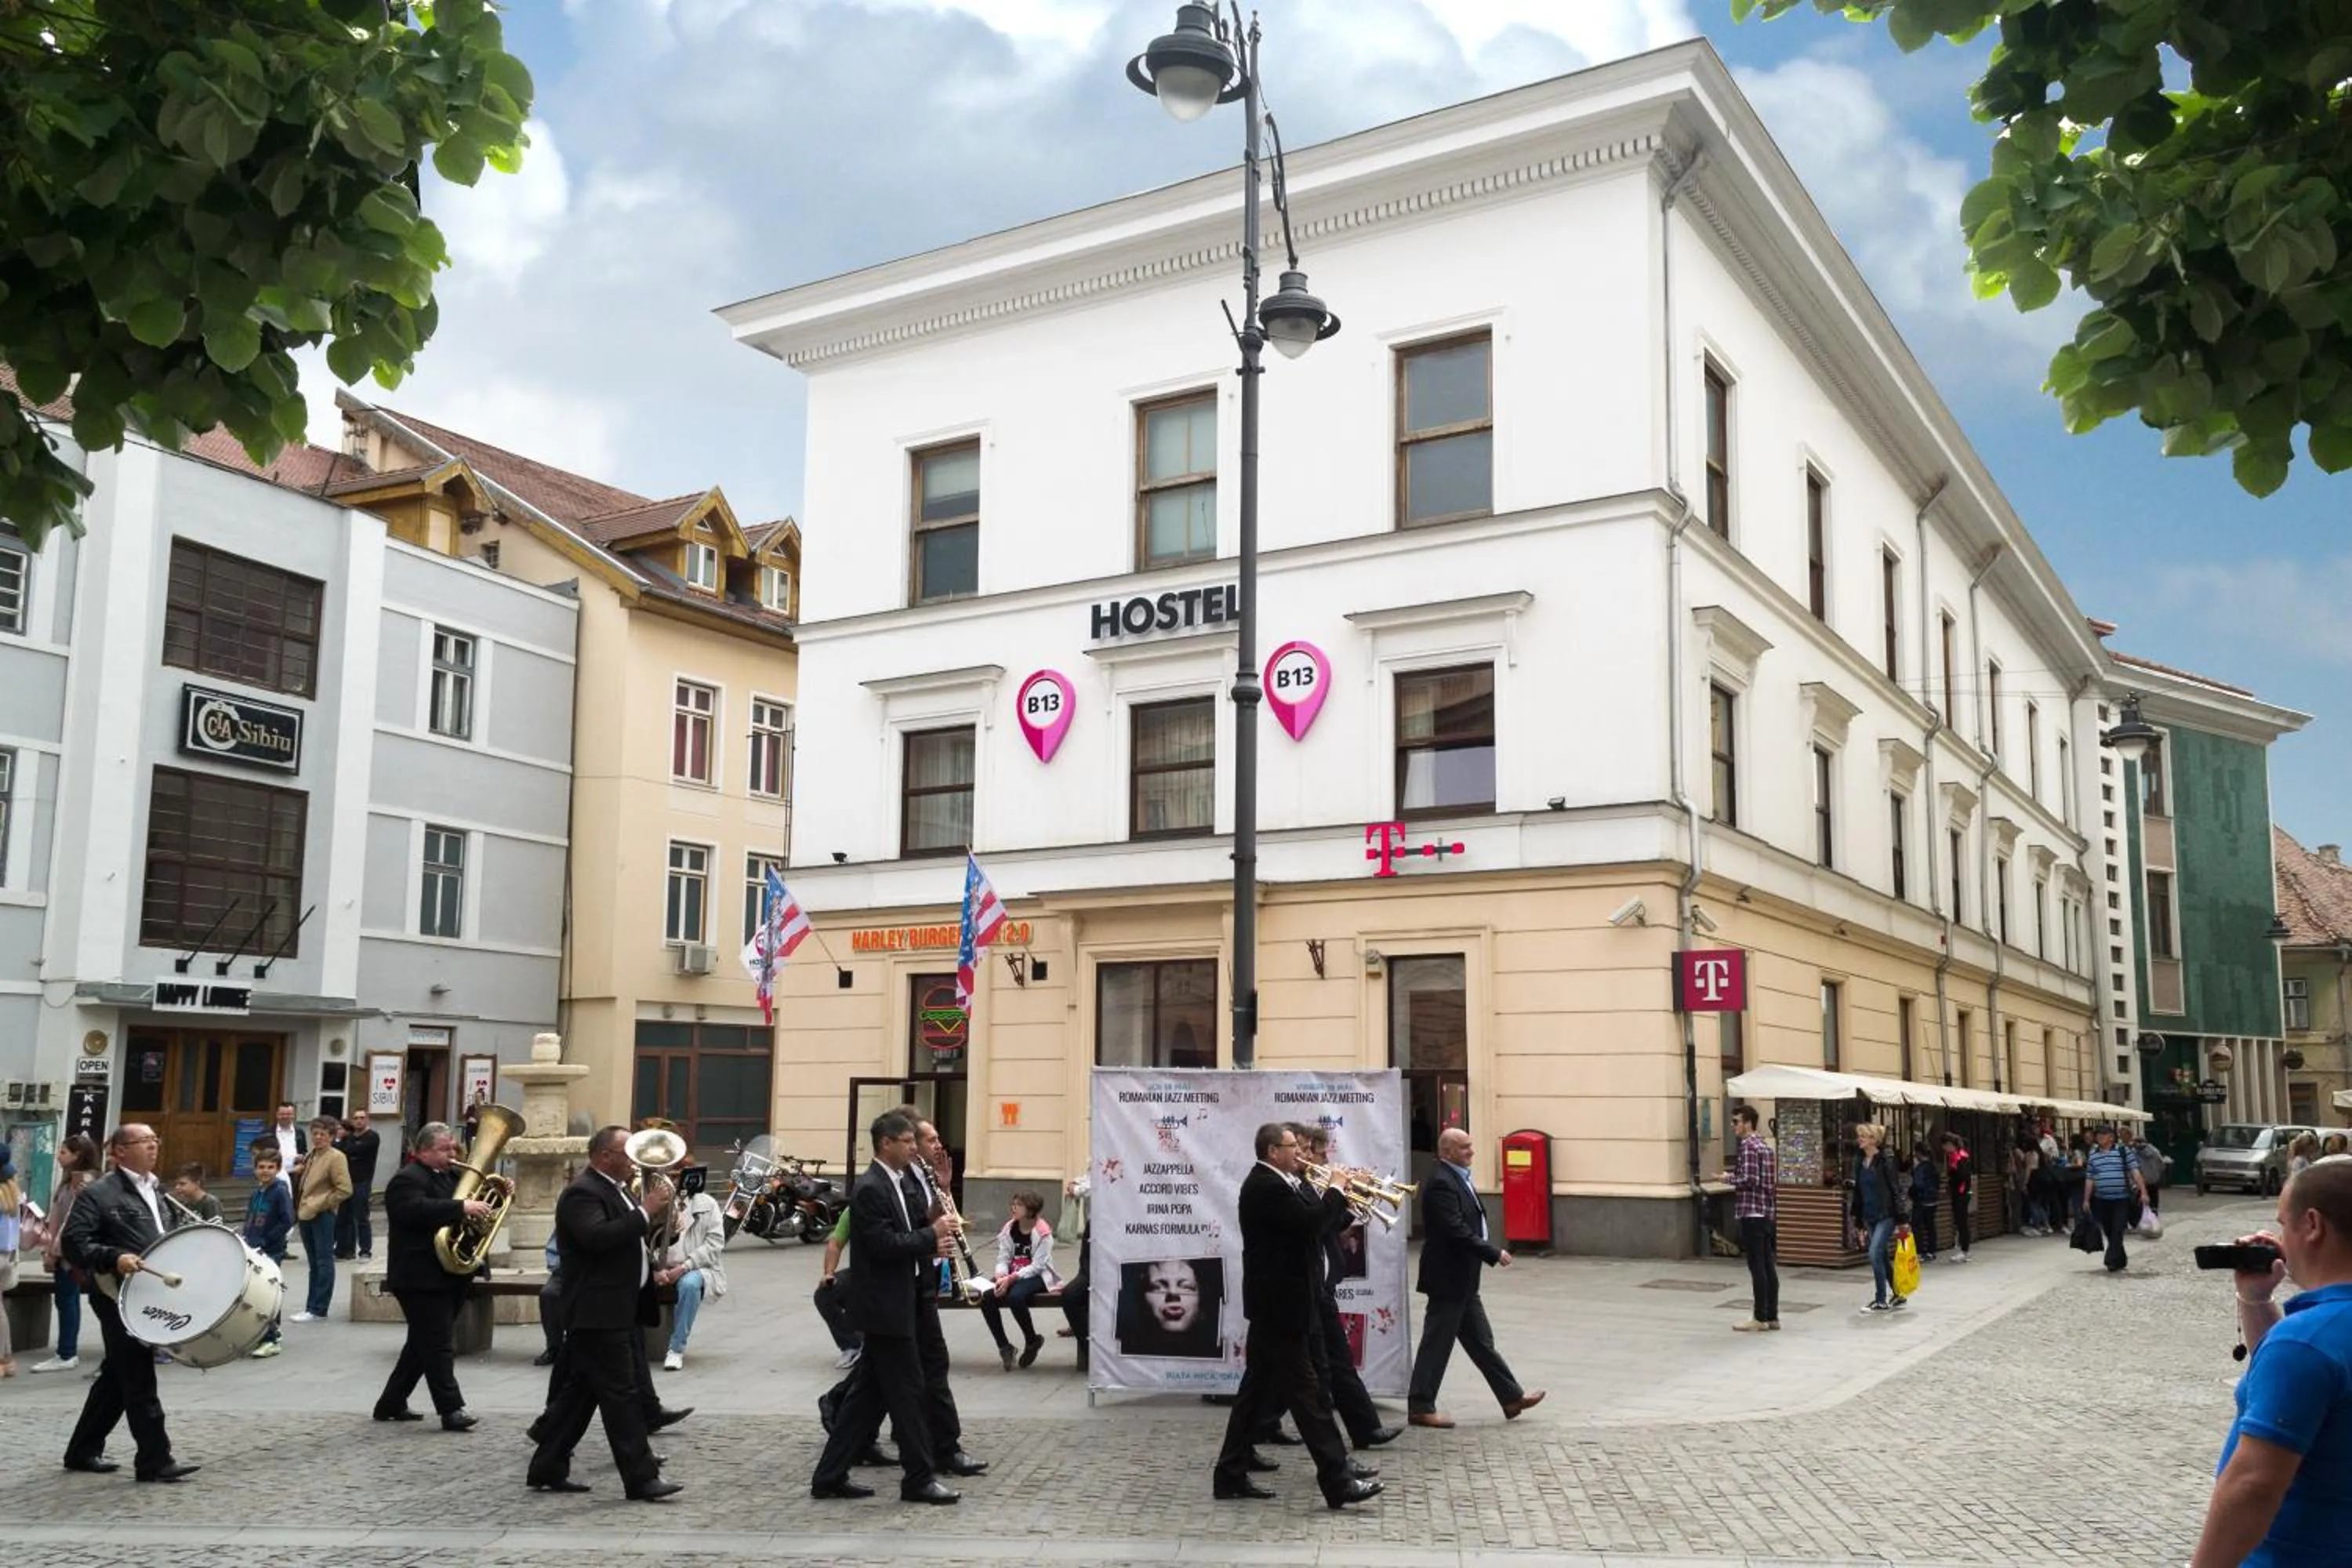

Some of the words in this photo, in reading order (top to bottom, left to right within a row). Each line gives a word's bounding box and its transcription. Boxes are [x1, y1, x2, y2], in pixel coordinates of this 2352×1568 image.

[1091, 585, 1240, 639] HOSTEL
[1277, 666, 1315, 688] B13
[1028, 693, 1060, 714] B13
[238, 720, 292, 753] Sibiu
[852, 929, 904, 951] HARLEY
[79, 1060, 109, 1071] OPEN
[1119, 1091, 1163, 1103] ROMANIAN
[1164, 1092, 1183, 1103] JAZZ
[1184, 1092, 1220, 1104] MEETING
[1274, 1091, 1319, 1103] ROMANIAN
[1320, 1092, 1338, 1103] JAZZ
[1338, 1092, 1375, 1104] MEETING
[1143, 1163, 1194, 1175] JAZZAPPELLA
[1139, 1183, 1174, 1194] ACCORD
[1147, 1203, 1169, 1214] IRINA
[1171, 1203, 1192, 1214] POPA
[1125, 1223, 1160, 1235] KARNAS
[1160, 1223, 1200, 1235] FORMULA
